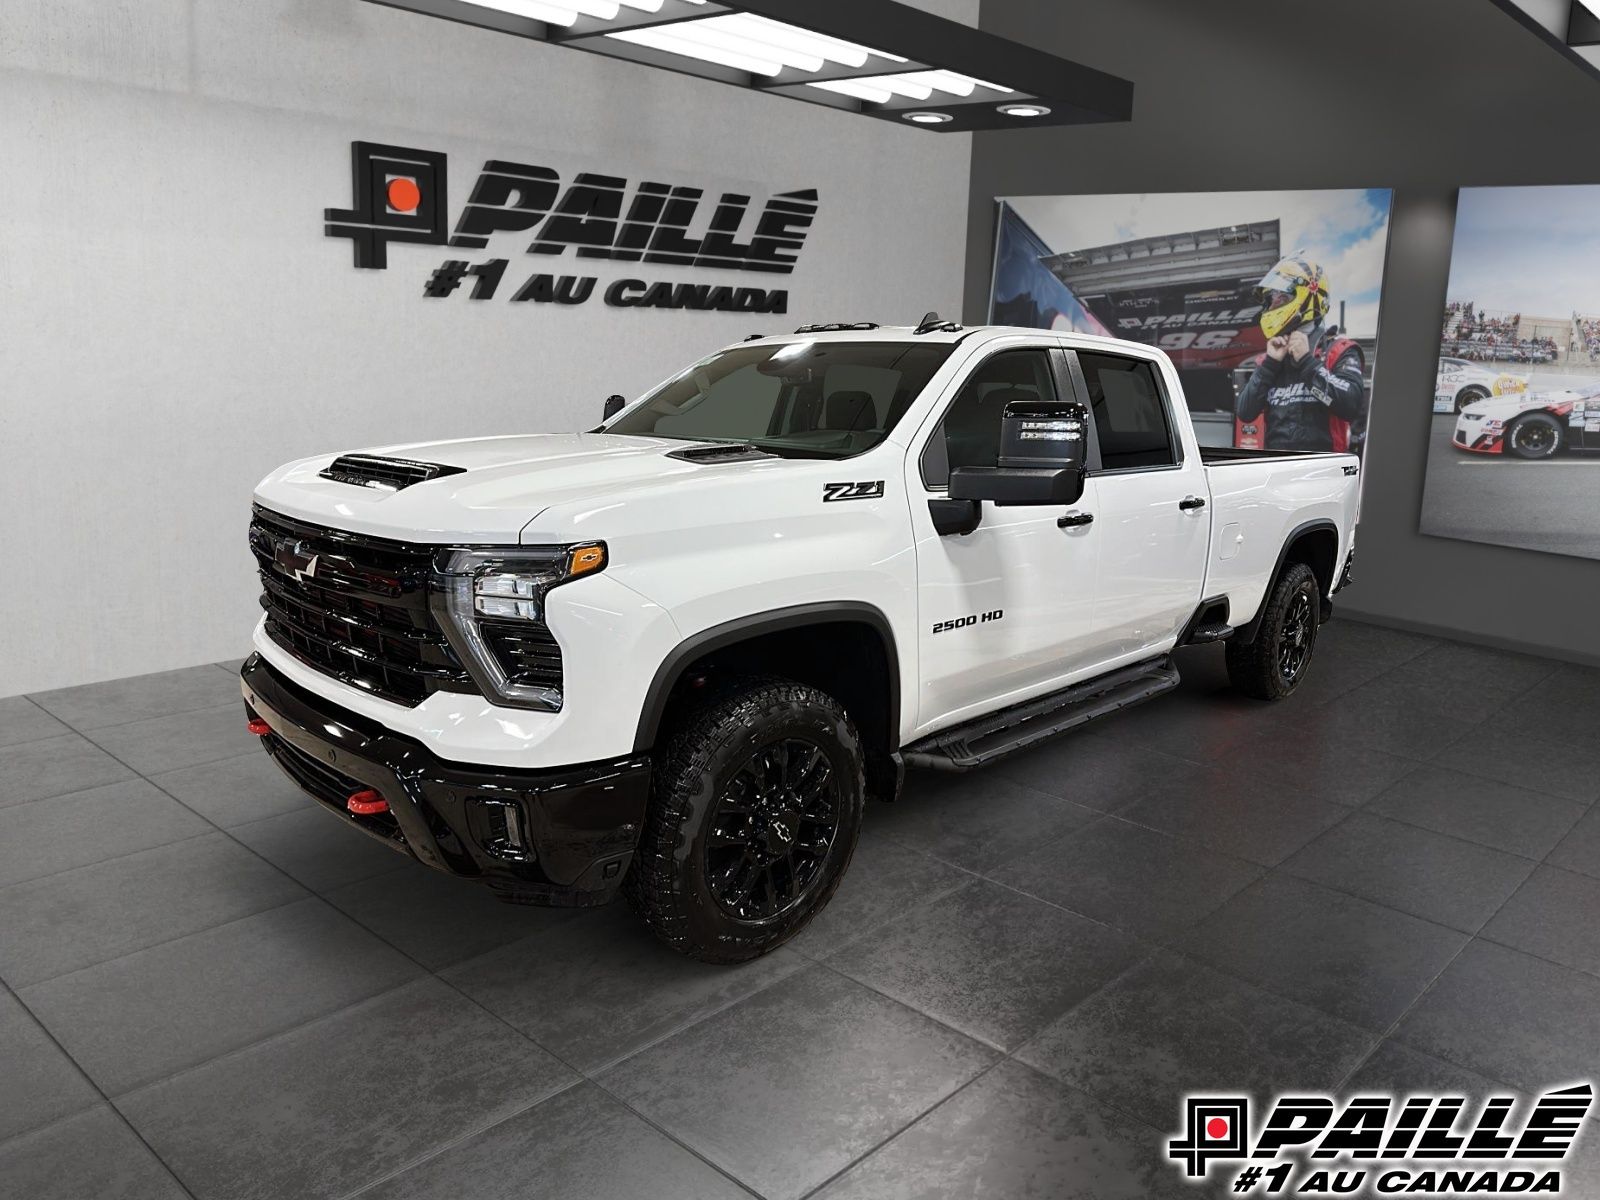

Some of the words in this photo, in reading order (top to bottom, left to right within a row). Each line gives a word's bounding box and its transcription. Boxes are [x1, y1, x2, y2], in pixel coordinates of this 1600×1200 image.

[448, 160, 819, 274] PAILLÉ
[422, 259, 510, 300] #1
[510, 273, 598, 304] AU
[603, 279, 788, 314] CANADA
[1160, 330, 1240, 350] 96
[932, 615, 977, 634] 2500
[981, 610, 1003, 623] HD
